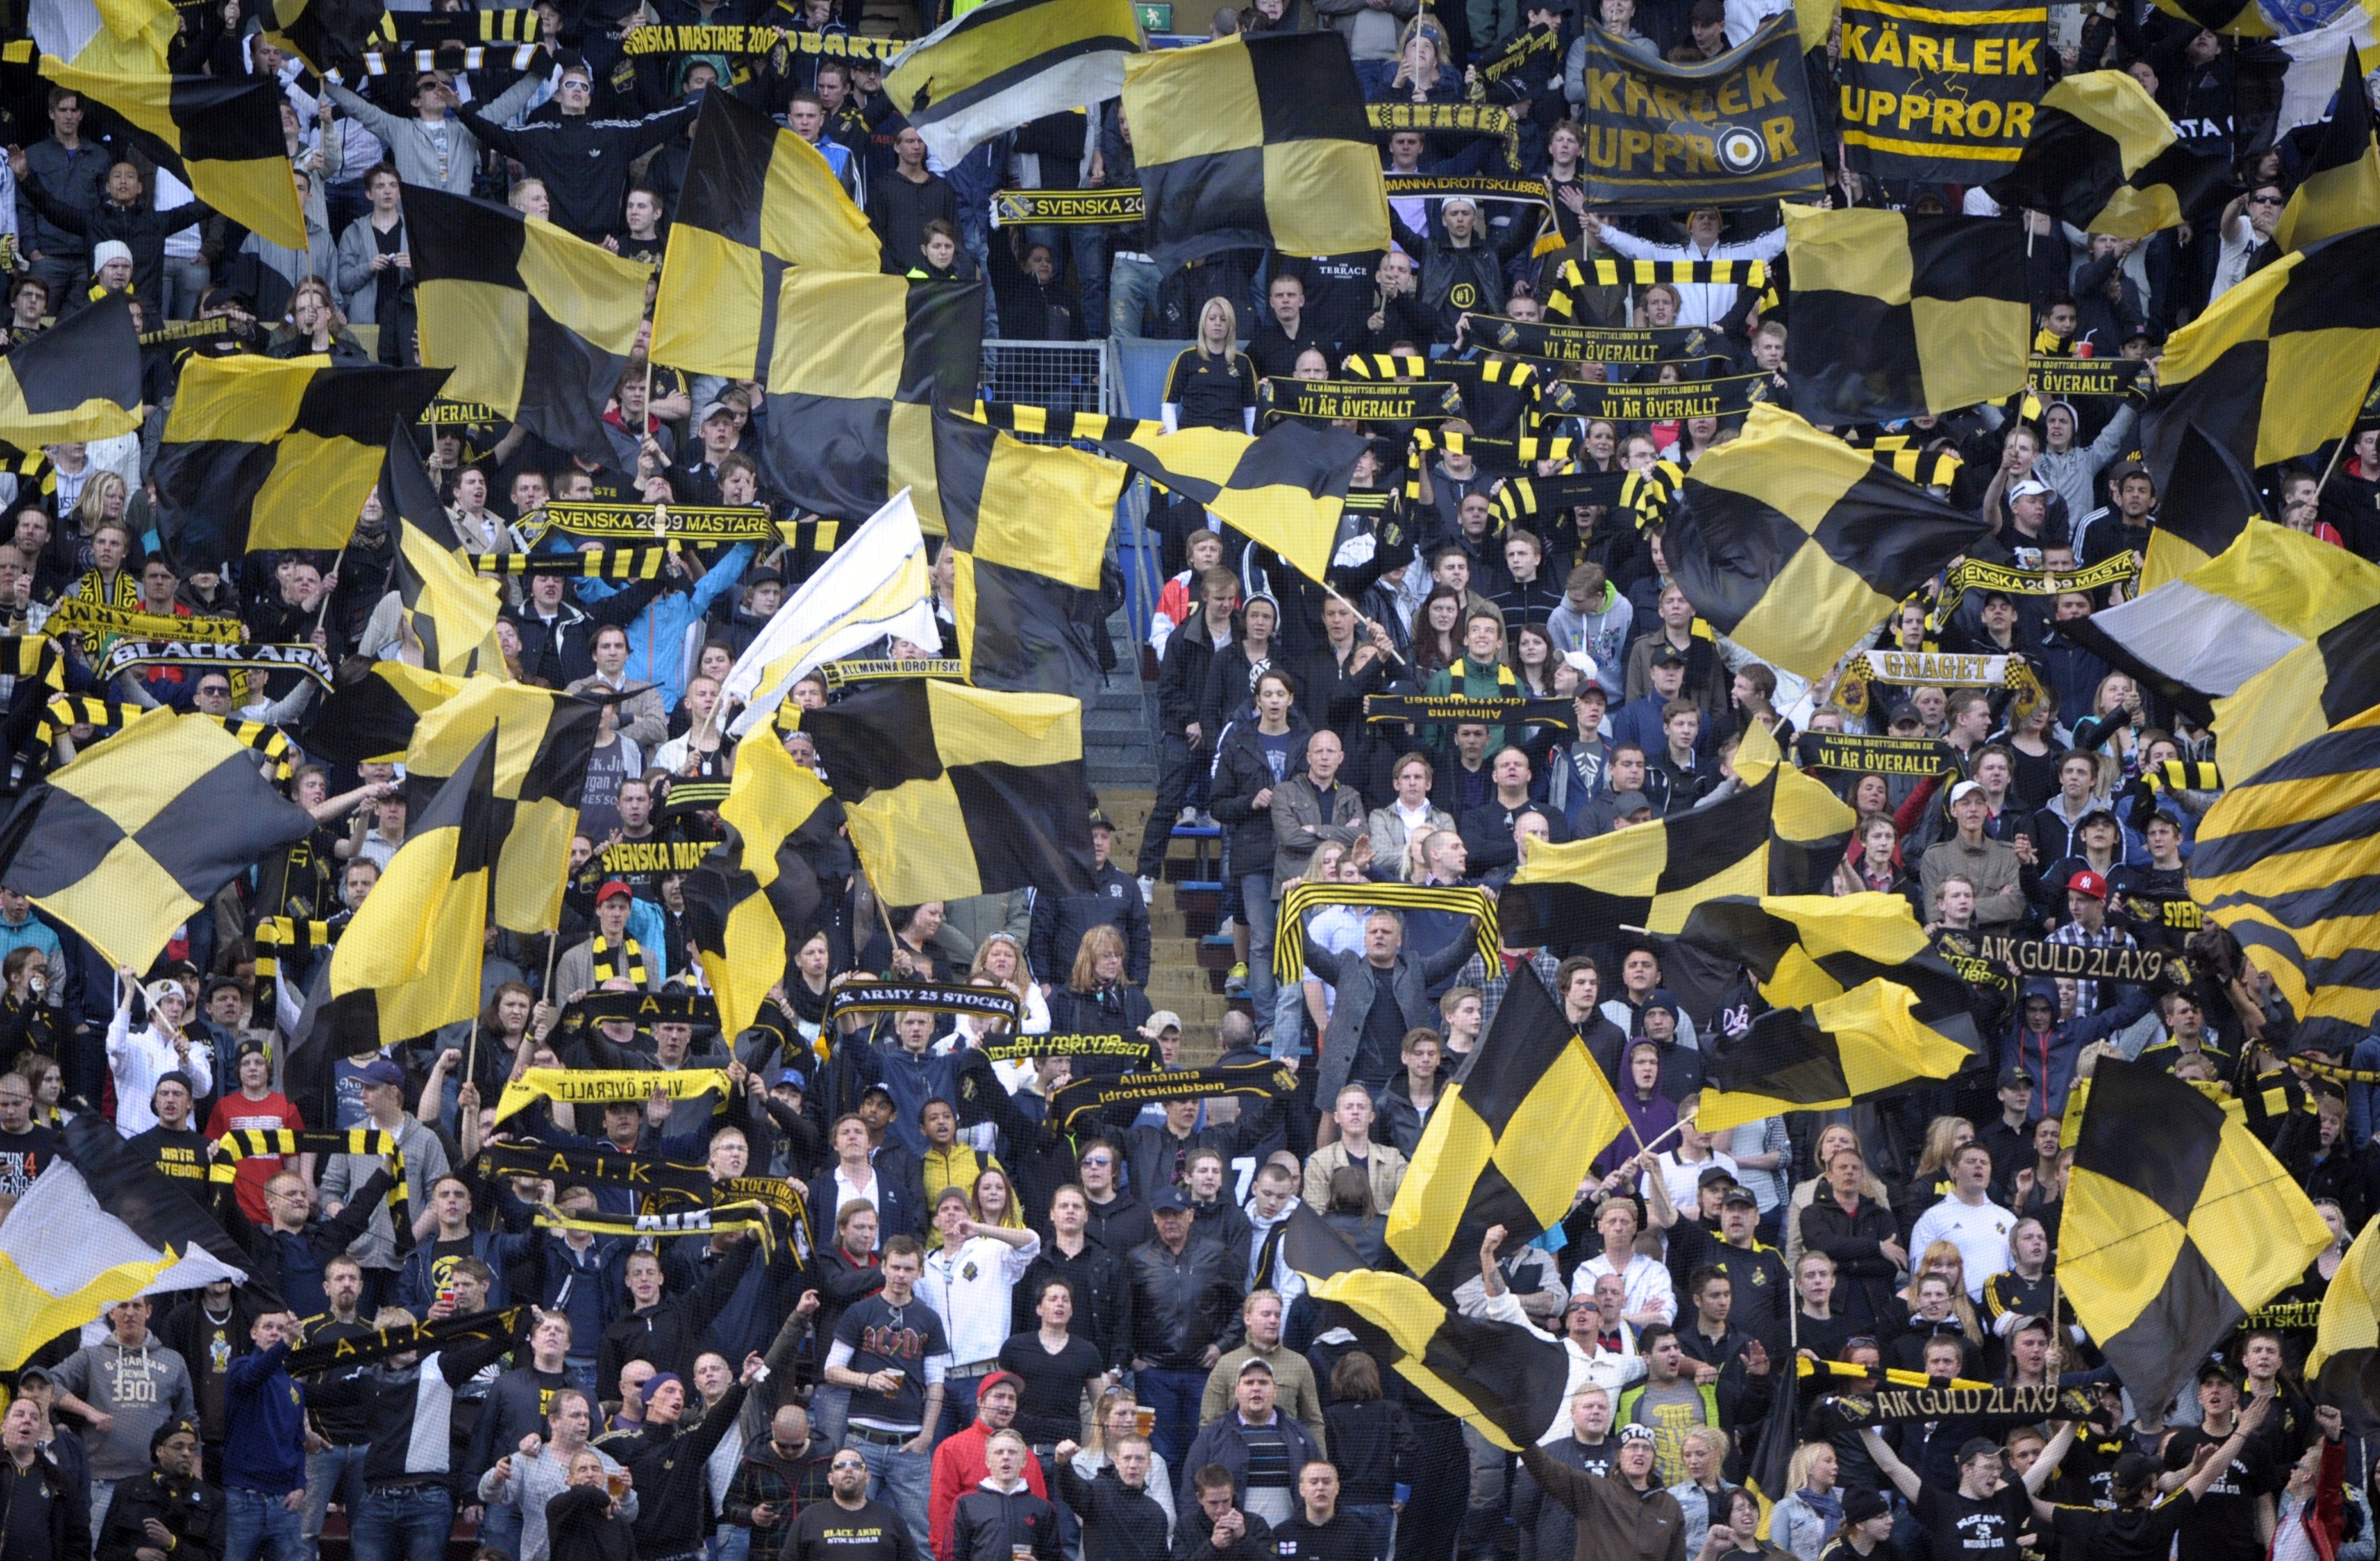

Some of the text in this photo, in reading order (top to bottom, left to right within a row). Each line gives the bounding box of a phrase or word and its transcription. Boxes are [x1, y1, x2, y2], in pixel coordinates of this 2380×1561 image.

[1842, 22, 2040, 76] KÄRLEK
[1586, 58, 1788, 123] KÄRLEK
[1841, 85, 2035, 138] UPPROR
[1438, 178, 1549, 198] IDROTTSKLUBBEN
[1037, 199, 1122, 215] SVENSKA
[1319, 266, 1367, 276] TERRACE
[1456, 289, 1470, 303] #1
[1544, 339, 1658, 361] VI ÄR ÖVERALLT
[2043, 370, 2118, 391] ÖVERALLT
[1298, 394, 1416, 418] VI ÄR ÖVERALLT
[1601, 397, 1720, 417] VI ÄR ÖVERALLT
[549, 510, 634, 528] SVENSKA
[685, 514, 769, 533] MÄSTARE
[1951, 566, 2024, 591] SVENSKA
[174, 623, 241, 637] ACK
[112, 643, 244, 666] BLACK
[1884, 653, 1992, 680] GNAGET
[1819, 746, 1941, 773] VI ÄR ÖVERALLT
[602, 842, 671, 873] SVENSKA
[1981, 934, 2162, 982] AIK GULD 2LAX9
[860, 989, 914, 1000] ARMY
[919, 990, 938, 1001] 25
[1099, 1082, 1225, 1103] Idrottsklubben
[1231, 1156, 1257, 1207] 7
[634, 1208, 712, 1231] AIK
[112, 1379, 157, 1403] 3301
[1876, 1385, 2059, 1419] AIK GULD 2LAX9
[823, 1528, 882, 1538] BLACK ARMY
